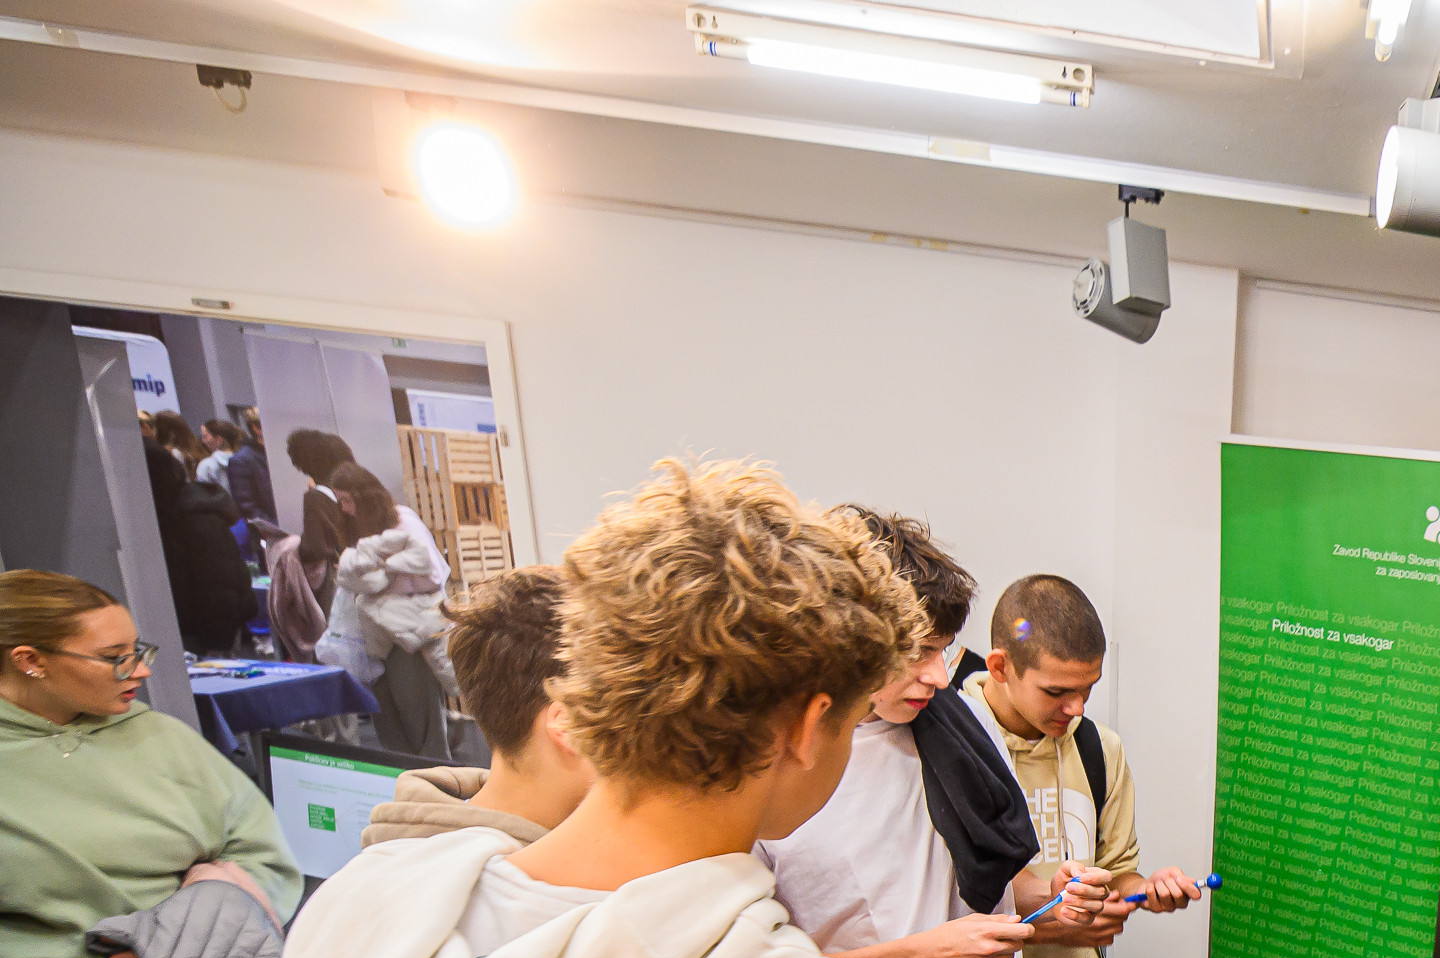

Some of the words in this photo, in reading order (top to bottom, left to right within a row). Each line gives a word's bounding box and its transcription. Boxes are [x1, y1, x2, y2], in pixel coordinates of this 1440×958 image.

[1333, 544, 1361, 558] Zavod
[1362, 547, 1406, 563] Republike
[1375, 566, 1387, 576] za
[1275, 601, 1328, 621] Priložnost
[1332, 612, 1345, 623] za
[1347, 615, 1399, 634] vsakogar
[1271, 619, 1324, 639] Priložnost
[1327, 630, 1340, 641] za
[1342, 633, 1394, 652] vsakogar
[1322, 648, 1336, 659] za
[1338, 650, 1388, 670] vsakogar
[1318, 665, 1331, 676] za
[1334, 668, 1384, 688] vsakogar
[1313, 682, 1326, 693] za
[1329, 685, 1379, 705] vsakogar
[1381, 692, 1438, 714] Priložnost
[1305, 716, 1318, 727] za
[1319, 719, 1369, 739] vsakogar
[1371, 727, 1427, 749] Priložnost
[1310, 700, 1322, 711] za
[1325, 702, 1374, 722] vsakogar
[1376, 710, 1432, 732] Priložnost
[1297, 749, 1309, 760] za
[1311, 752, 1360, 773] vsakogar
[1362, 761, 1416, 783] Priložnost
[1420, 775, 1434, 787] za
[1301, 733, 1314, 744] za
[1315, 736, 1365, 756] vsakogar
[1367, 744, 1421, 766] Priložnost
[1425, 758, 1440, 770] za
[1022, 787, 1058, 813] HE
[1289, 781, 1300, 792] za
[1303, 785, 1350, 805] vsakogar
[1353, 793, 1406, 817] Priložnost
[1409, 809, 1423, 820] za
[1293, 765, 1305, 777] za
[1307, 769, 1355, 789] vsakogar
[1358, 777, 1411, 800] Priložnost
[1414, 792, 1429, 804] za
[1281, 813, 1293, 824] za
[1295, 816, 1341, 837] vsakogar
[1344, 825, 1396, 849] Priložnost
[1399, 841, 1412, 853] za
[1284, 797, 1297, 808] za
[1299, 801, 1346, 821] vsakogar
[1348, 809, 1401, 833] Priložnost
[1404, 825, 1418, 837] za
[1273, 843, 1285, 855] za
[1287, 847, 1333, 868] vsakogar
[1335, 857, 1386, 881] Priložnost
[1389, 873, 1402, 885] za
[1277, 828, 1289, 839] za
[1291, 832, 1337, 853] vsakogar
[1340, 841, 1391, 865] Priložnost
[1394, 857, 1408, 869] za
[1283, 862, 1329, 883] vsakogar
[1331, 872, 1382, 896] Priložnost
[1385, 889, 1398, 901] za
